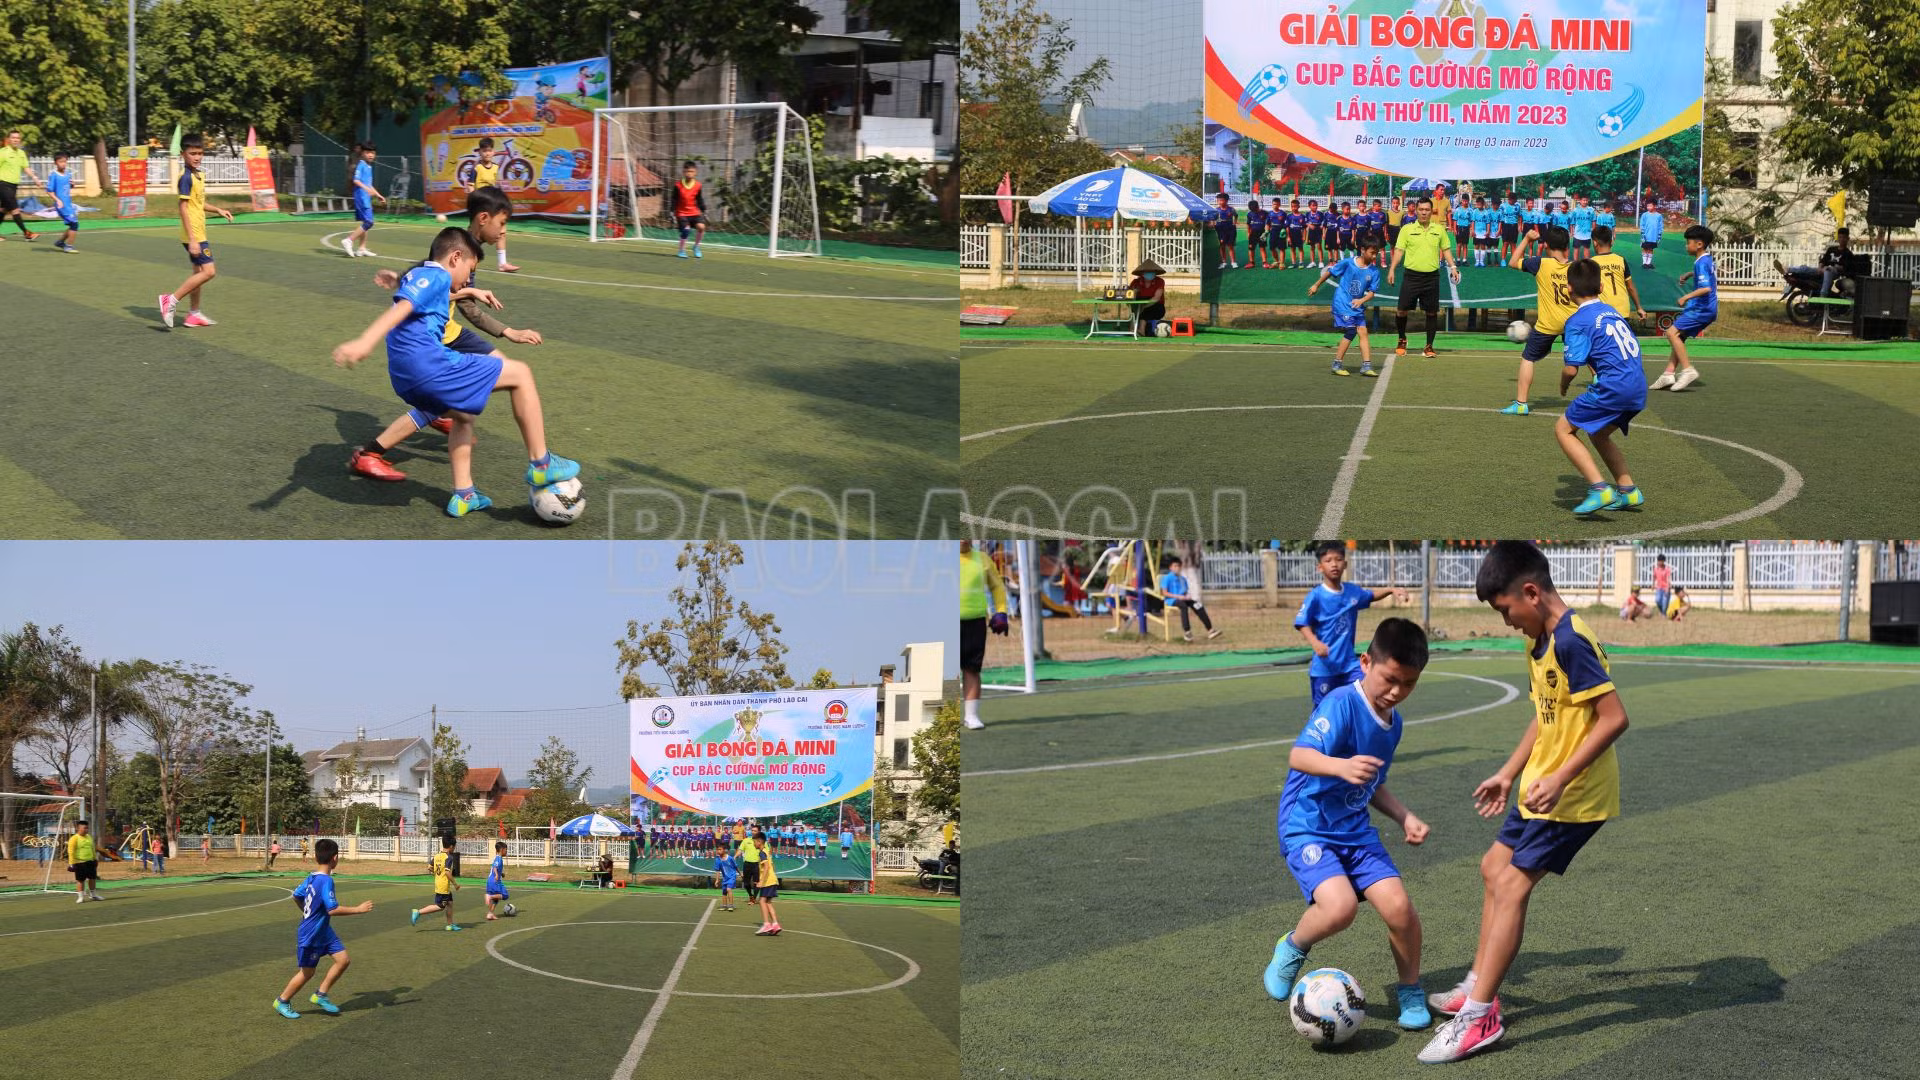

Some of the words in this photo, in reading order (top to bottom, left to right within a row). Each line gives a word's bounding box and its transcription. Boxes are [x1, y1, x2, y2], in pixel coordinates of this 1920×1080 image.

[1279, 5, 1358, 46] GIẢI
[1371, 10, 1474, 49] BÓNG
[1485, 13, 1539, 50] ĐÁ
[1551, 19, 1631, 51] MINI
[1296, 63, 1344, 86] CUP
[1353, 56, 1401, 87] BẮC
[1409, 61, 1491, 89] CƯỜNG
[1500, 60, 1539, 91] MỞ
[1546, 64, 1612, 96] RỘNG
[1336, 95, 1376, 121] LẦN
[1383, 99, 1424, 122] THỨ
[1429, 103, 1456, 125] III,
[1462, 100, 1511, 124] NĂM
[1517, 105, 1567, 124] 2023
[1439, 136, 1451, 146] 17
[1484, 137, 1497, 147] 03
[1523, 137, 1548, 148] 2023
[1552, 282, 1570, 305] 15
[1605, 272, 1617, 296] 7
[1605, 319, 1640, 360] 18
[664, 739, 702, 758] GIẢI
[707, 739, 757, 757] BÓNG
[762, 738, 788, 756] ĐÁ
[794, 739, 836, 756] MINI
[672, 765, 695, 776] CUP
[778, 781, 803, 791] 2023
